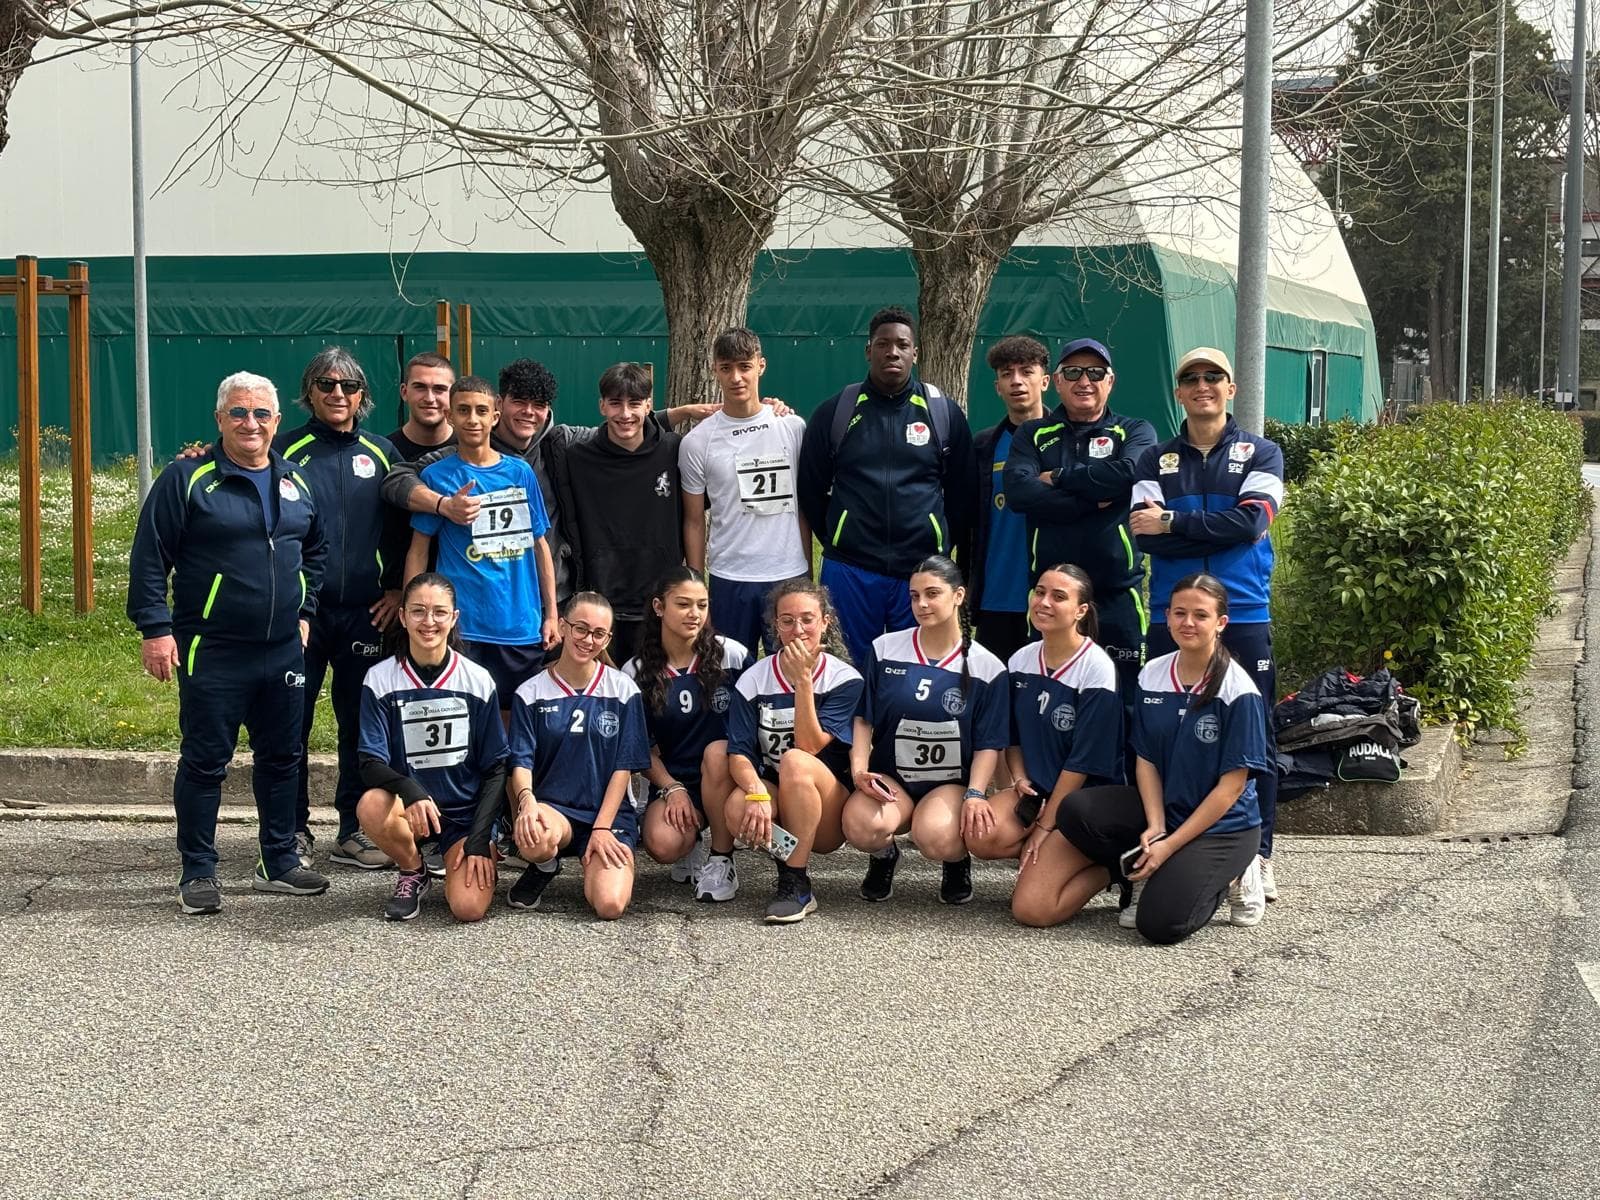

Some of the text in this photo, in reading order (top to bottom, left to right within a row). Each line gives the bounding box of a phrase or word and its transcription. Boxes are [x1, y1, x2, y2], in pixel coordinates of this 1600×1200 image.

[732, 423, 769, 437] GIVOVA
[752, 472, 777, 495] 21
[488, 507, 514, 531] 19
[885, 667, 907, 675] ONZE
[914, 678, 932, 701] 5
[679, 690, 693, 714] 9
[570, 709, 585, 733] 2
[425, 722, 452, 747] 31
[768, 732, 795, 755] 23
[914, 744, 945, 765] 30
